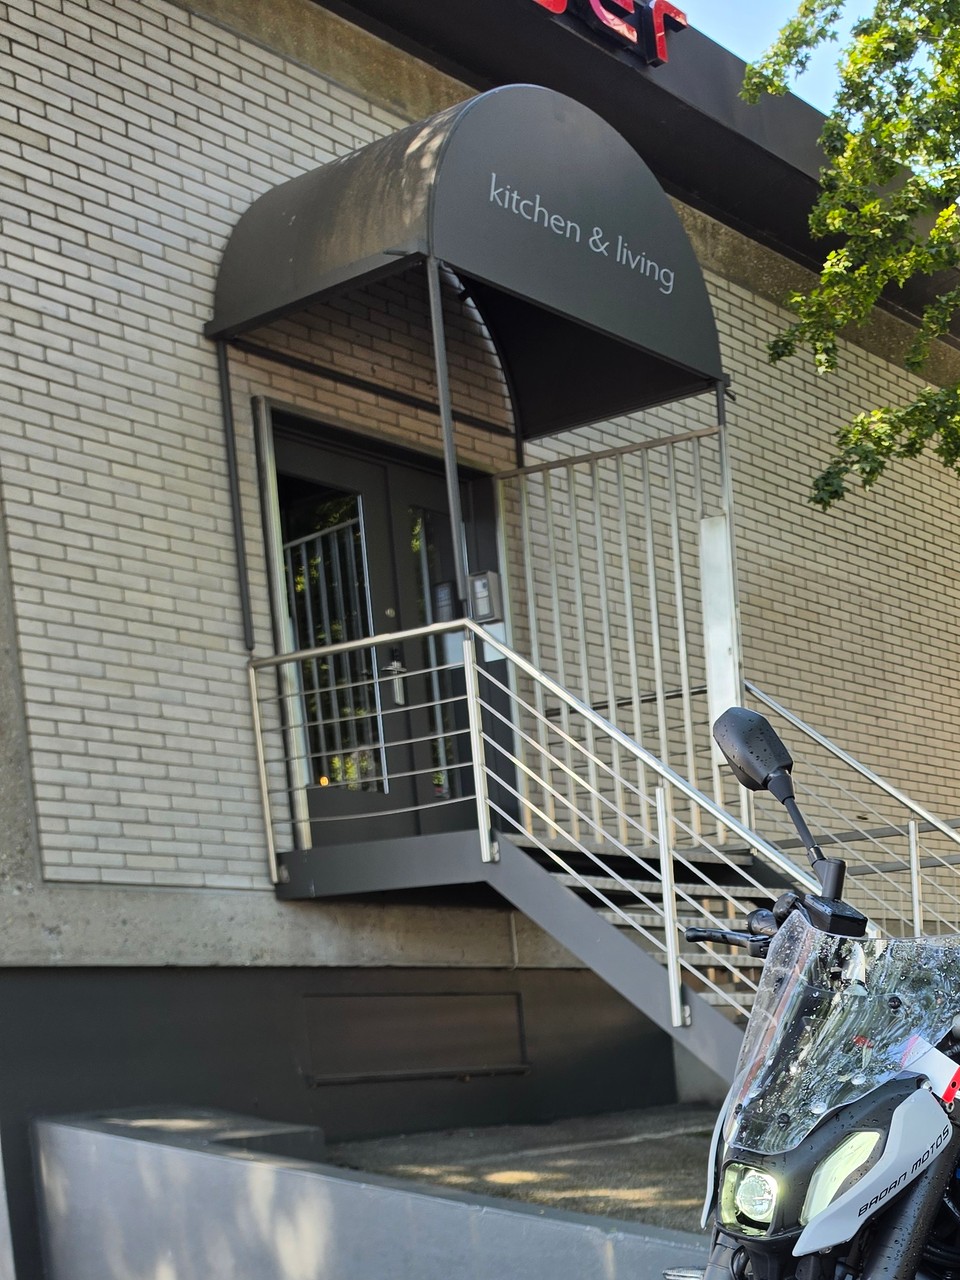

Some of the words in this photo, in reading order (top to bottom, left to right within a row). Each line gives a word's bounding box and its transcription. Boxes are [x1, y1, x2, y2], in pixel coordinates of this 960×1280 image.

[489, 172, 581, 243] kitchen
[588, 226, 609, 257] &
[616, 235, 675, 295] living
[857, 1171, 908, 1218] BADAN
[911, 1124, 949, 1174] MOTOS
